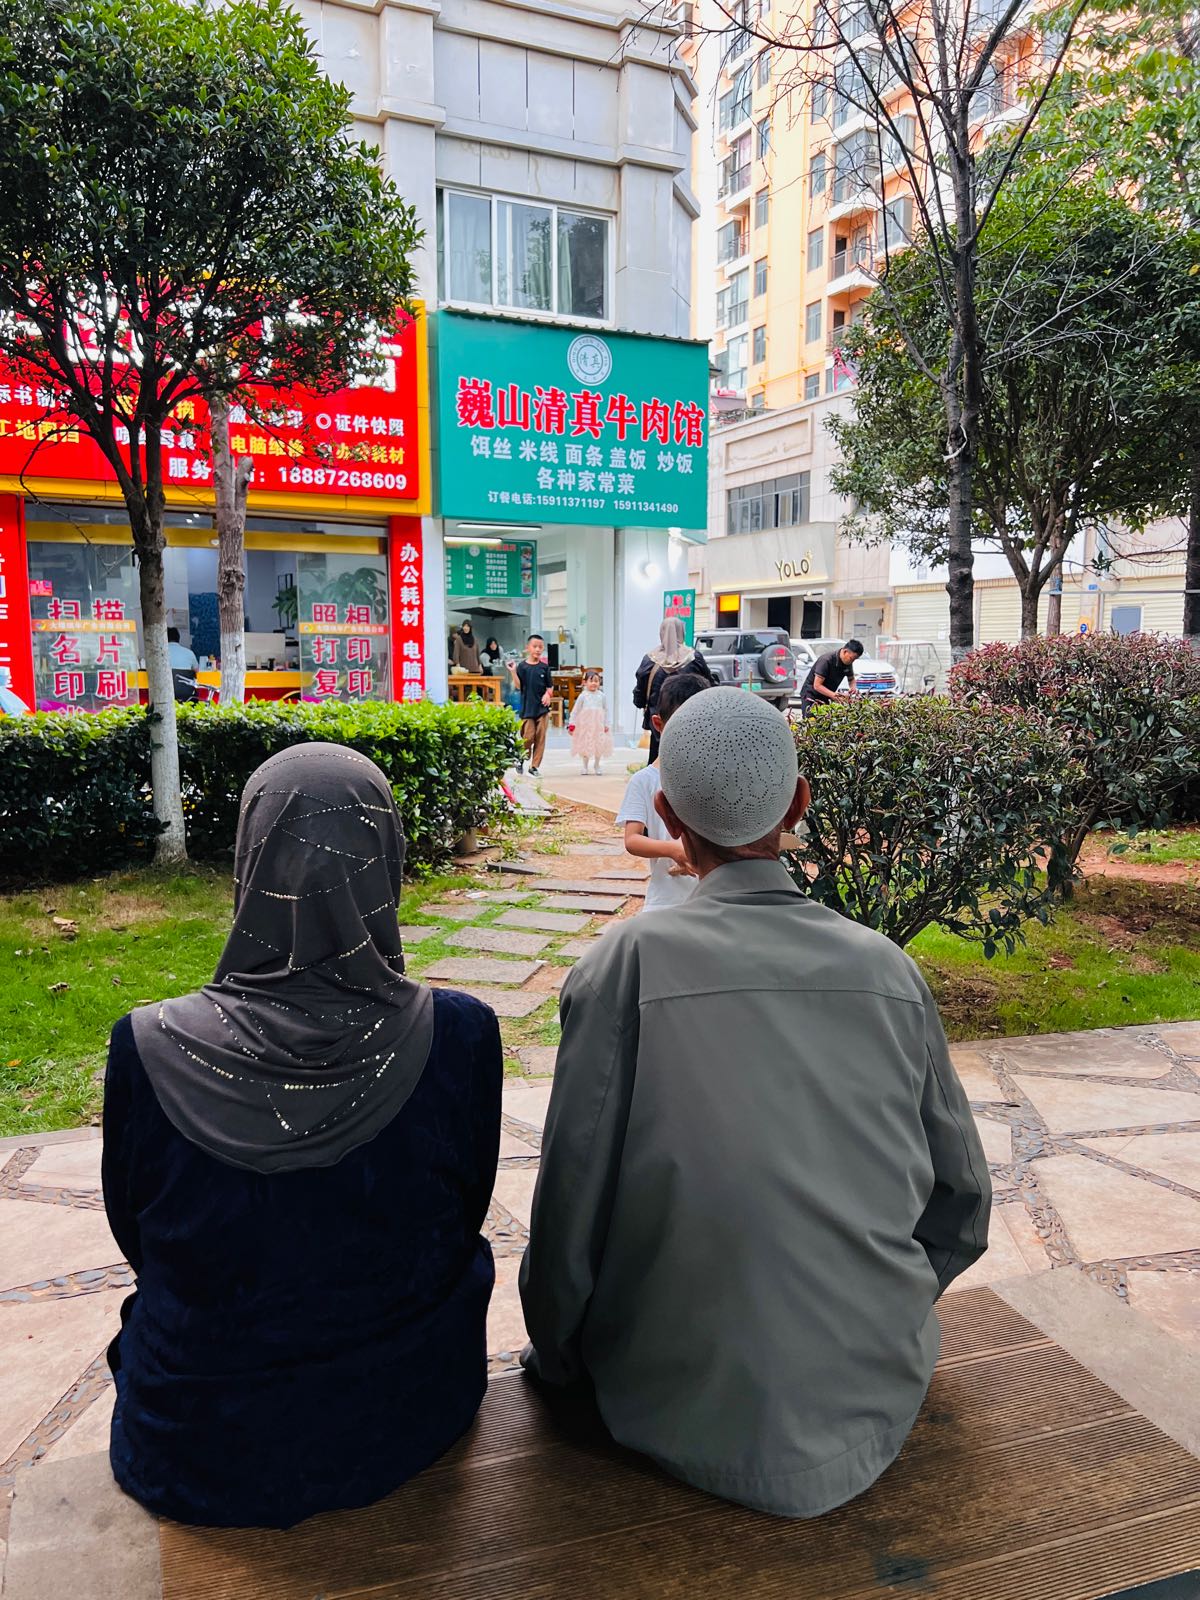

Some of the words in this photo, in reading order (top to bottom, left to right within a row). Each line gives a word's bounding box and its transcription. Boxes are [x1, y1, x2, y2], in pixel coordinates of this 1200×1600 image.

[336, 413, 404, 437] 证件快照
[456, 376, 705, 447] 巍山清真牛肉馆
[231, 434, 305, 458] 电脑维修
[470, 434, 512, 460] 饵丝
[519, 439, 559, 464] 米线
[565, 443, 604, 468] 面条
[609, 447, 646, 471] 盖饭
[657, 451, 693, 474] 炒饭
[278, 466, 407, 490] 18887268609
[536, 467, 636, 494] 各种家常菜
[613, 500, 679, 513] 15911341490
[400, 542, 420, 627] 办公耗材
[48, 597, 126, 620] 扫描
[312, 603, 371, 624] 照相
[50, 634, 124, 664] 名片
[312, 635, 373, 664] 打印
[53, 669, 129, 700] 印刷
[314, 667, 373, 697] 复印
